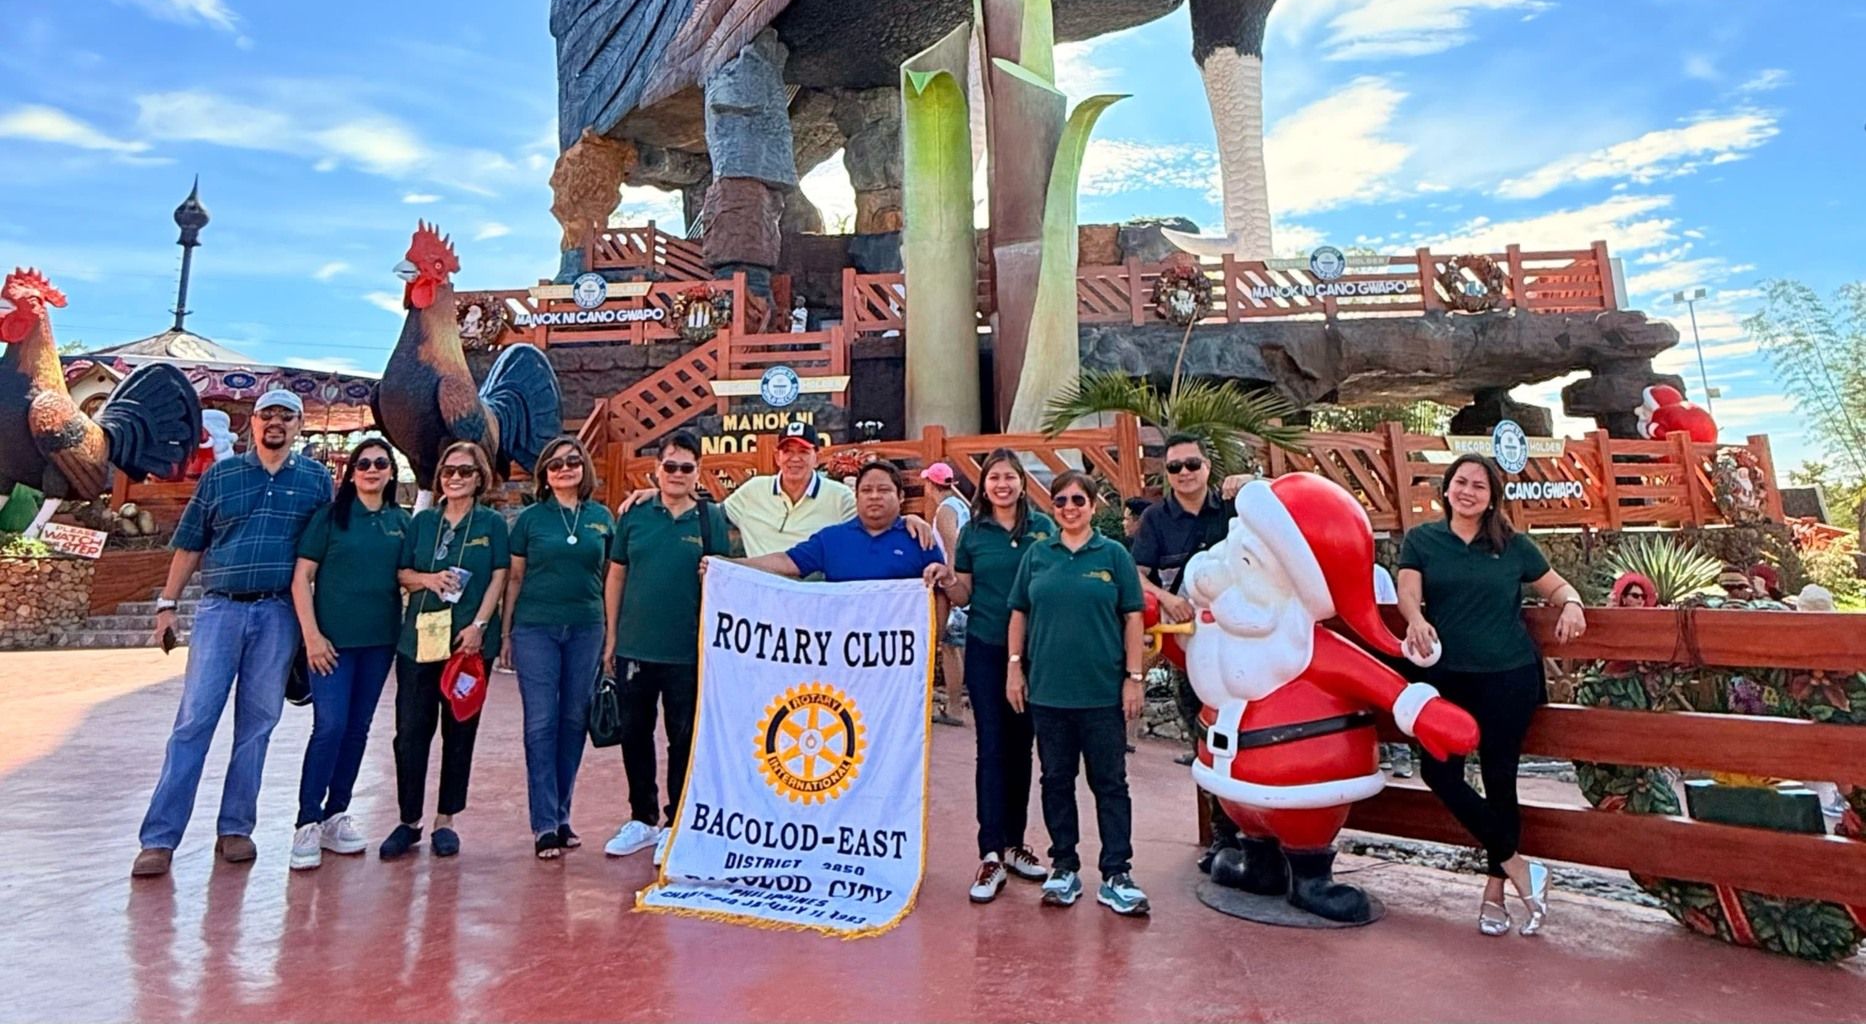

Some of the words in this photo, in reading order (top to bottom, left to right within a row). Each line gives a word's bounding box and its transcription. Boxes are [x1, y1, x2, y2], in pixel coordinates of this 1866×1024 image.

[1252, 285, 1299, 299] MANOK
[1301, 285, 1314, 297] NI
[1316, 284, 1355, 297] CANO
[1358, 281, 1407, 295] GWAPO
[514, 311, 561, 326] MANOK
[563, 311, 575, 324] NI
[576, 310, 615, 324] CANO
[616, 308, 665, 322] GWAPO
[723, 412, 790, 432] MANOK
[1455, 440, 1491, 452] RECORD
[1529, 441, 1561, 452] HOLDER
[1505, 481, 1541, 500] CANO
[1543, 480, 1583, 500] GWAPO
[45, 530, 102, 546] WATCH
[56, 526, 97, 537] PLEASE
[62, 541, 99, 555] STEP
[712, 611, 833, 667] ROTARY
[843, 629, 915, 668] CLUB
[791, 693, 840, 710] ROTARY
[767, 756, 852, 792] INTERNATIONAL
[690, 802, 908, 859] BACOLOD-EAST
[723, 851, 803, 870] DISTRICT
[828, 879, 893, 904] CITY
